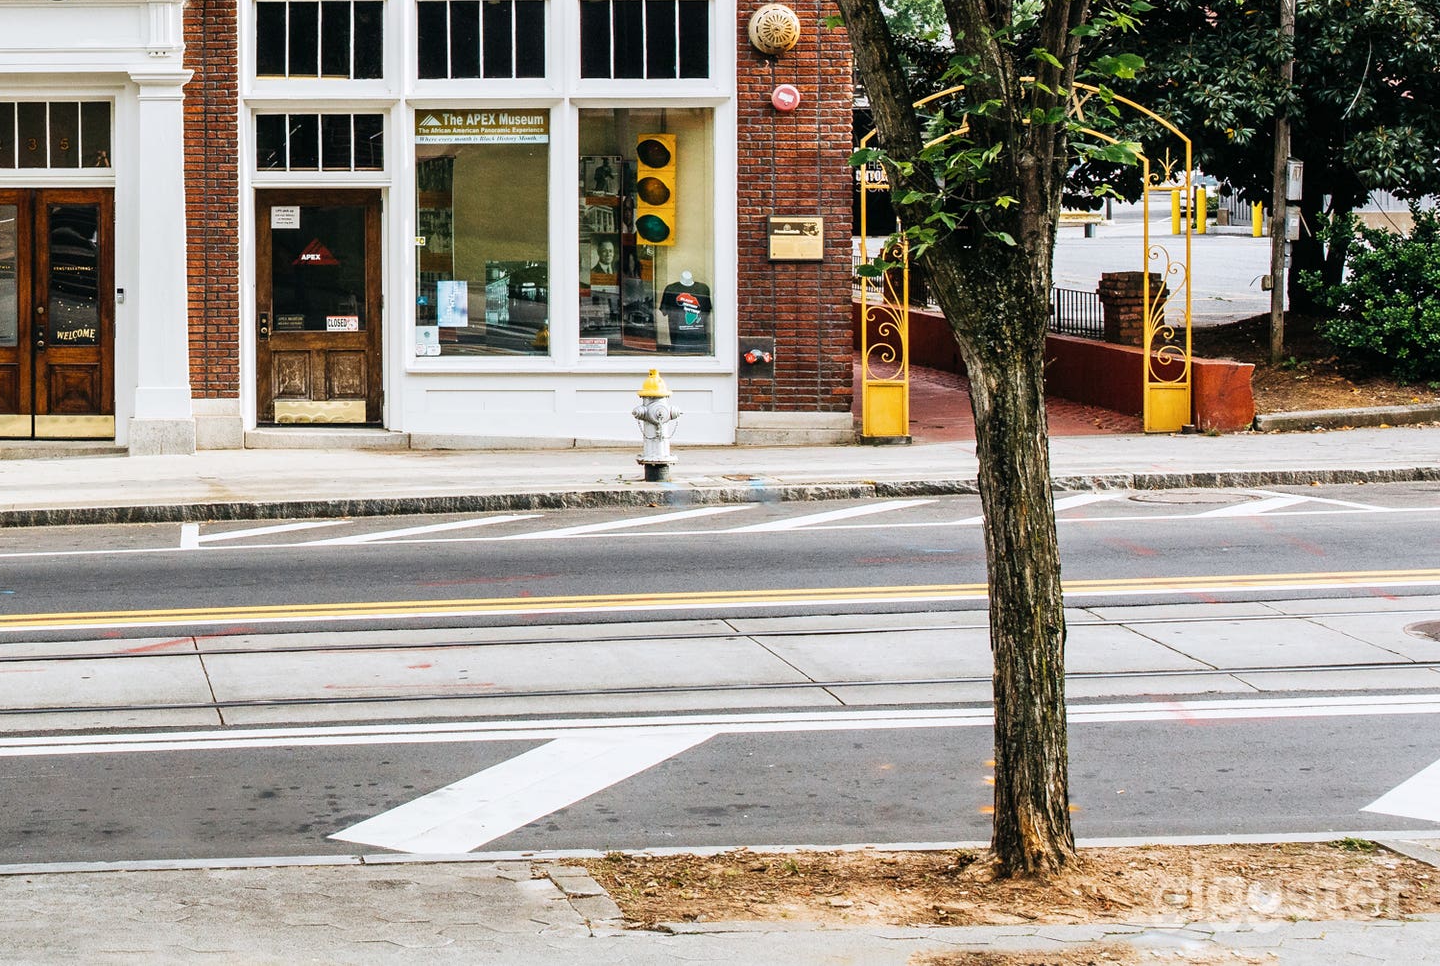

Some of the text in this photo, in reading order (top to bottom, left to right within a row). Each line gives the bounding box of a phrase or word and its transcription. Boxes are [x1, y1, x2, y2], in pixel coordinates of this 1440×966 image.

[442, 113, 544, 126] The APEX Museum
[301, 253, 321, 261] APEX
[327, 318, 348, 328] CLOSED
[56, 328, 96, 340] WELCOME
